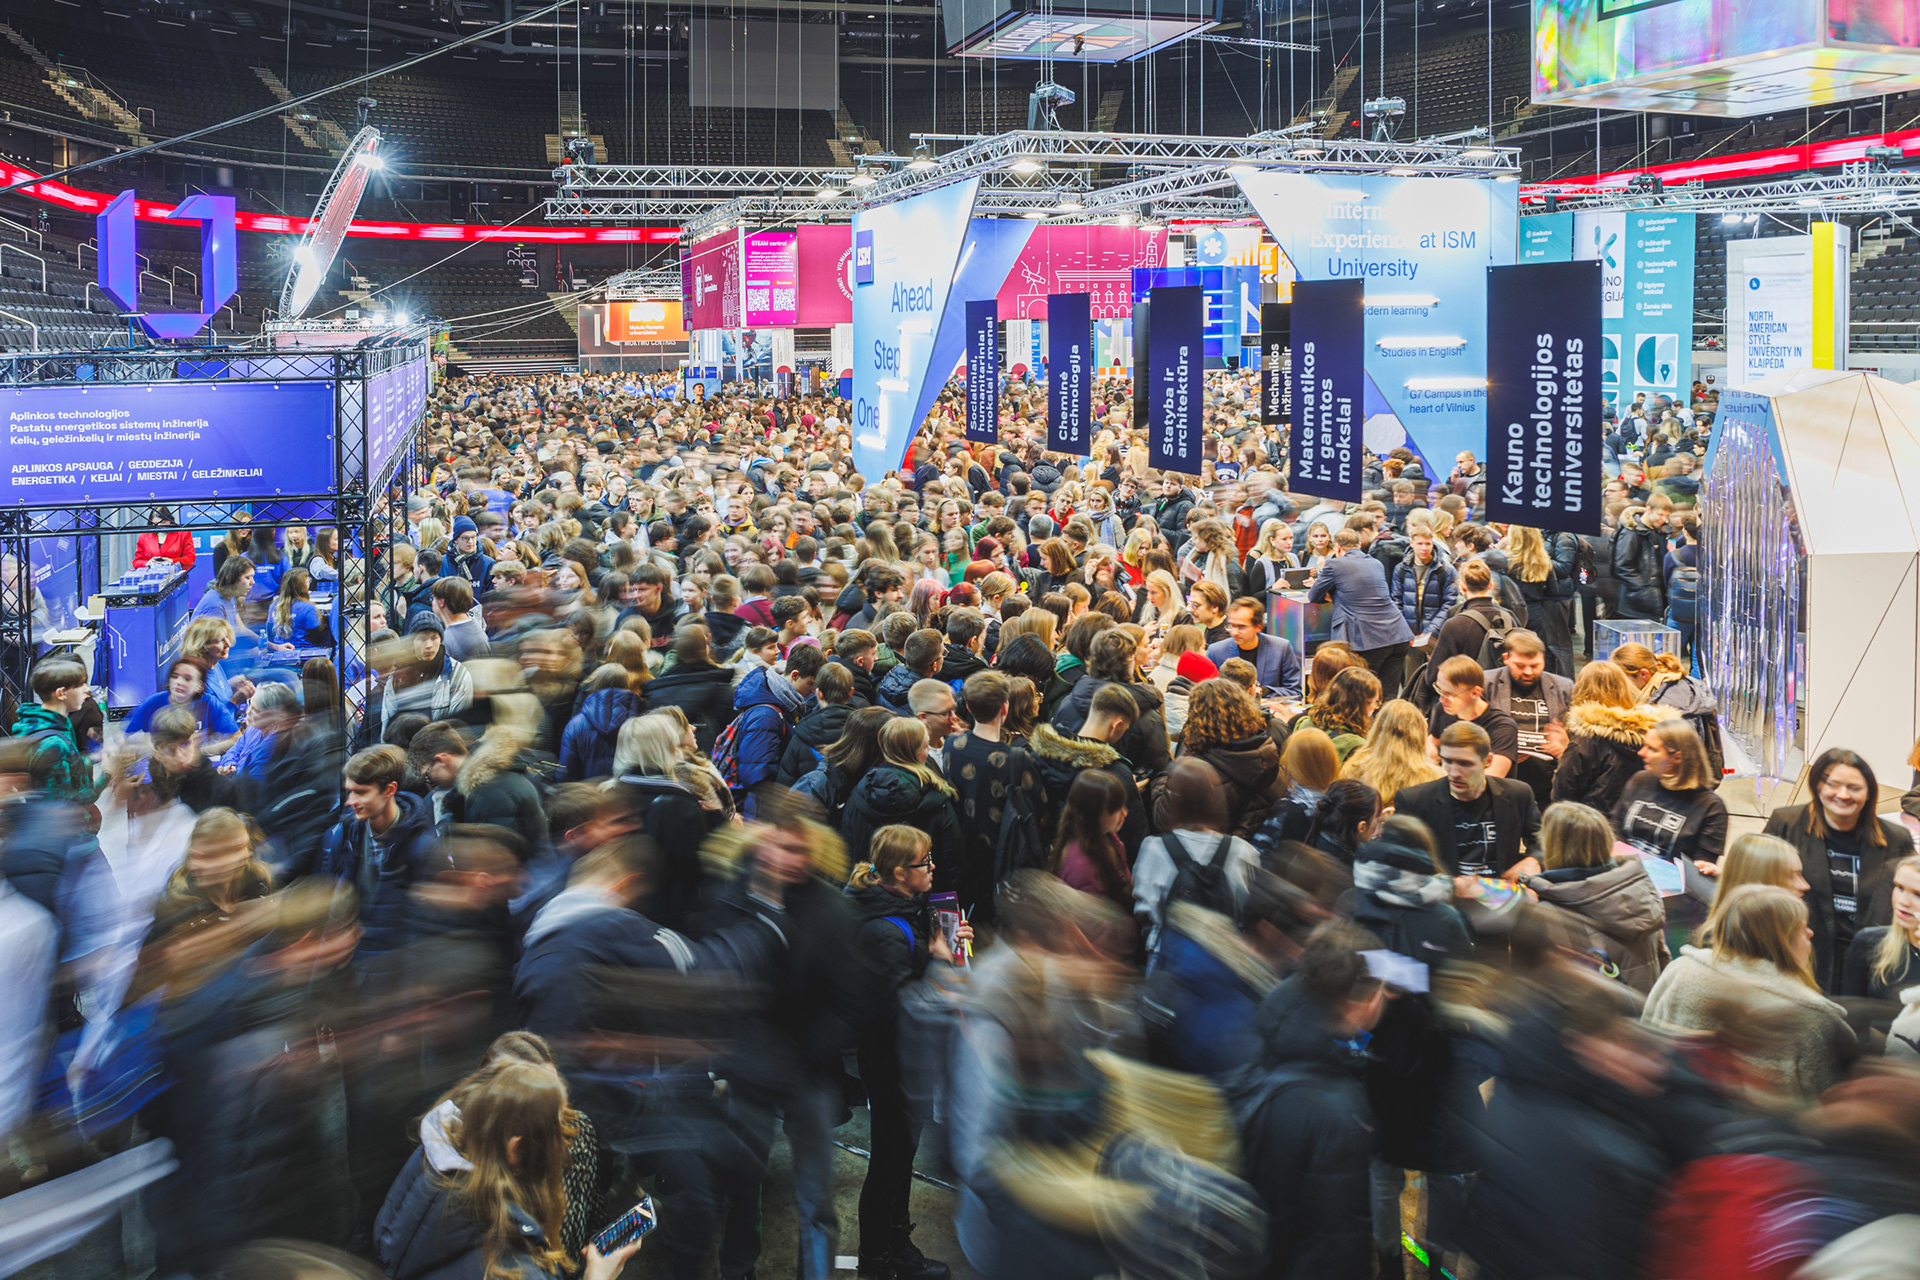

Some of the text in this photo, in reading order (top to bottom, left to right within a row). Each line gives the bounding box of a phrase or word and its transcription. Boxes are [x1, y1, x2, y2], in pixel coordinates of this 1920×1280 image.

[1420, 232, 1436, 249] at
[1443, 231, 1476, 249] ISM
[1328, 258, 1418, 280] University
[891, 278, 933, 313] Ahead
[1364, 306, 1429, 317] odern learning
[1749, 311, 1774, 322] NORTH
[985, 316, 993, 360] menai
[1749, 323, 1788, 333] AMERICAN
[1749, 335, 1771, 345] STYLE
[1281, 346, 1292, 356] ir
[1381, 347, 1462, 358] Studies in English
[1749, 346, 1802, 357] UNIVERSITY IN
[986, 363, 993, 373] ir
[1268, 343, 1279, 416] Mechanikos
[970, 355, 978, 430] Socialiniai,
[1069, 344, 1081, 442] technologija
[1176, 346, 1188, 458] architektūra
[1409, 388, 1487, 400] G7 Campus in the
[10, 409, 130, 422] Aplinkos technologijos
[857, 397, 881, 429] One
[1059, 371, 1069, 441] Cheminė
[1163, 368, 1176, 456] Statyba ir
[1299, 341, 1316, 479] Matematikos
[1409, 403, 1475, 414] heart of Vilnius
[10, 418, 209, 433] Pastatų energetikos sistemų inžinerija
[1317, 378, 1335, 482] ir gamtos
[1530, 333, 1559, 508] technologijos
[1560, 338, 1584, 512] universitetas
[10, 430, 200, 446] Kelių, geležinkelių ir miestų inžinerija
[1336, 397, 1352, 484] mokslai
[11, 463, 63, 474] APLINKOS
[65, 461, 114, 471] APSAUGA
[128, 459, 184, 469] GEODEZIJA
[1502, 422, 1524, 505] Kauno
[11, 475, 76, 486] ENERGETIKA
[90, 473, 123, 483] KELIAI
[137, 471, 178, 481] MIESTAI
[191, 467, 263, 479] GELEŽINKELIAI
